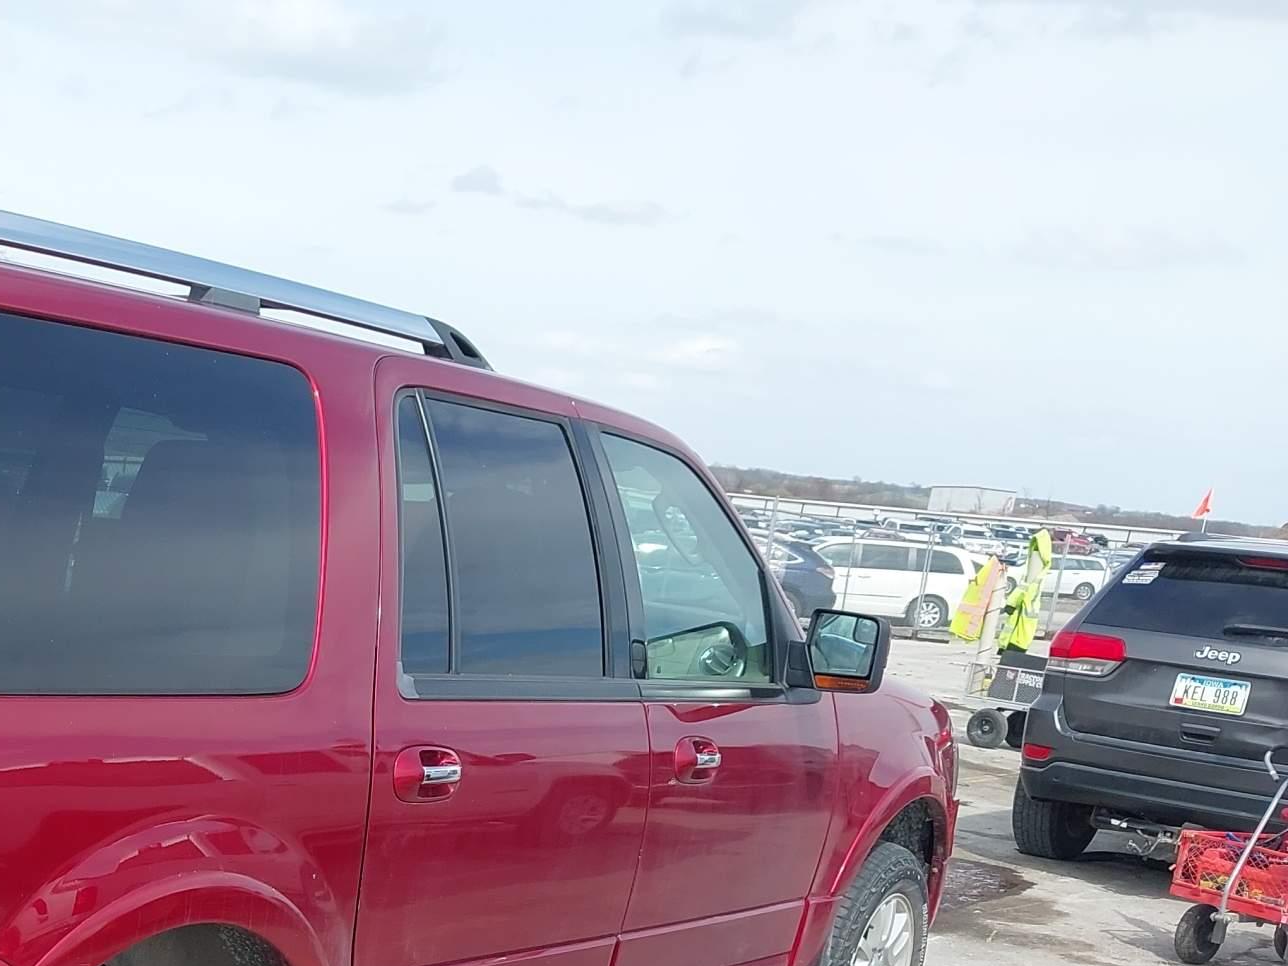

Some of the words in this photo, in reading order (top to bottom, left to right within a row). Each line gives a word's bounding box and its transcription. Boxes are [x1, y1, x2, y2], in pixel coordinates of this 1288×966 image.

[1195, 646, 1242, 665] Jeep
[1202, 679, 1225, 689] IOWA
[1182, 684, 1207, 702] KEL
[1212, 688, 1239, 706] 988
